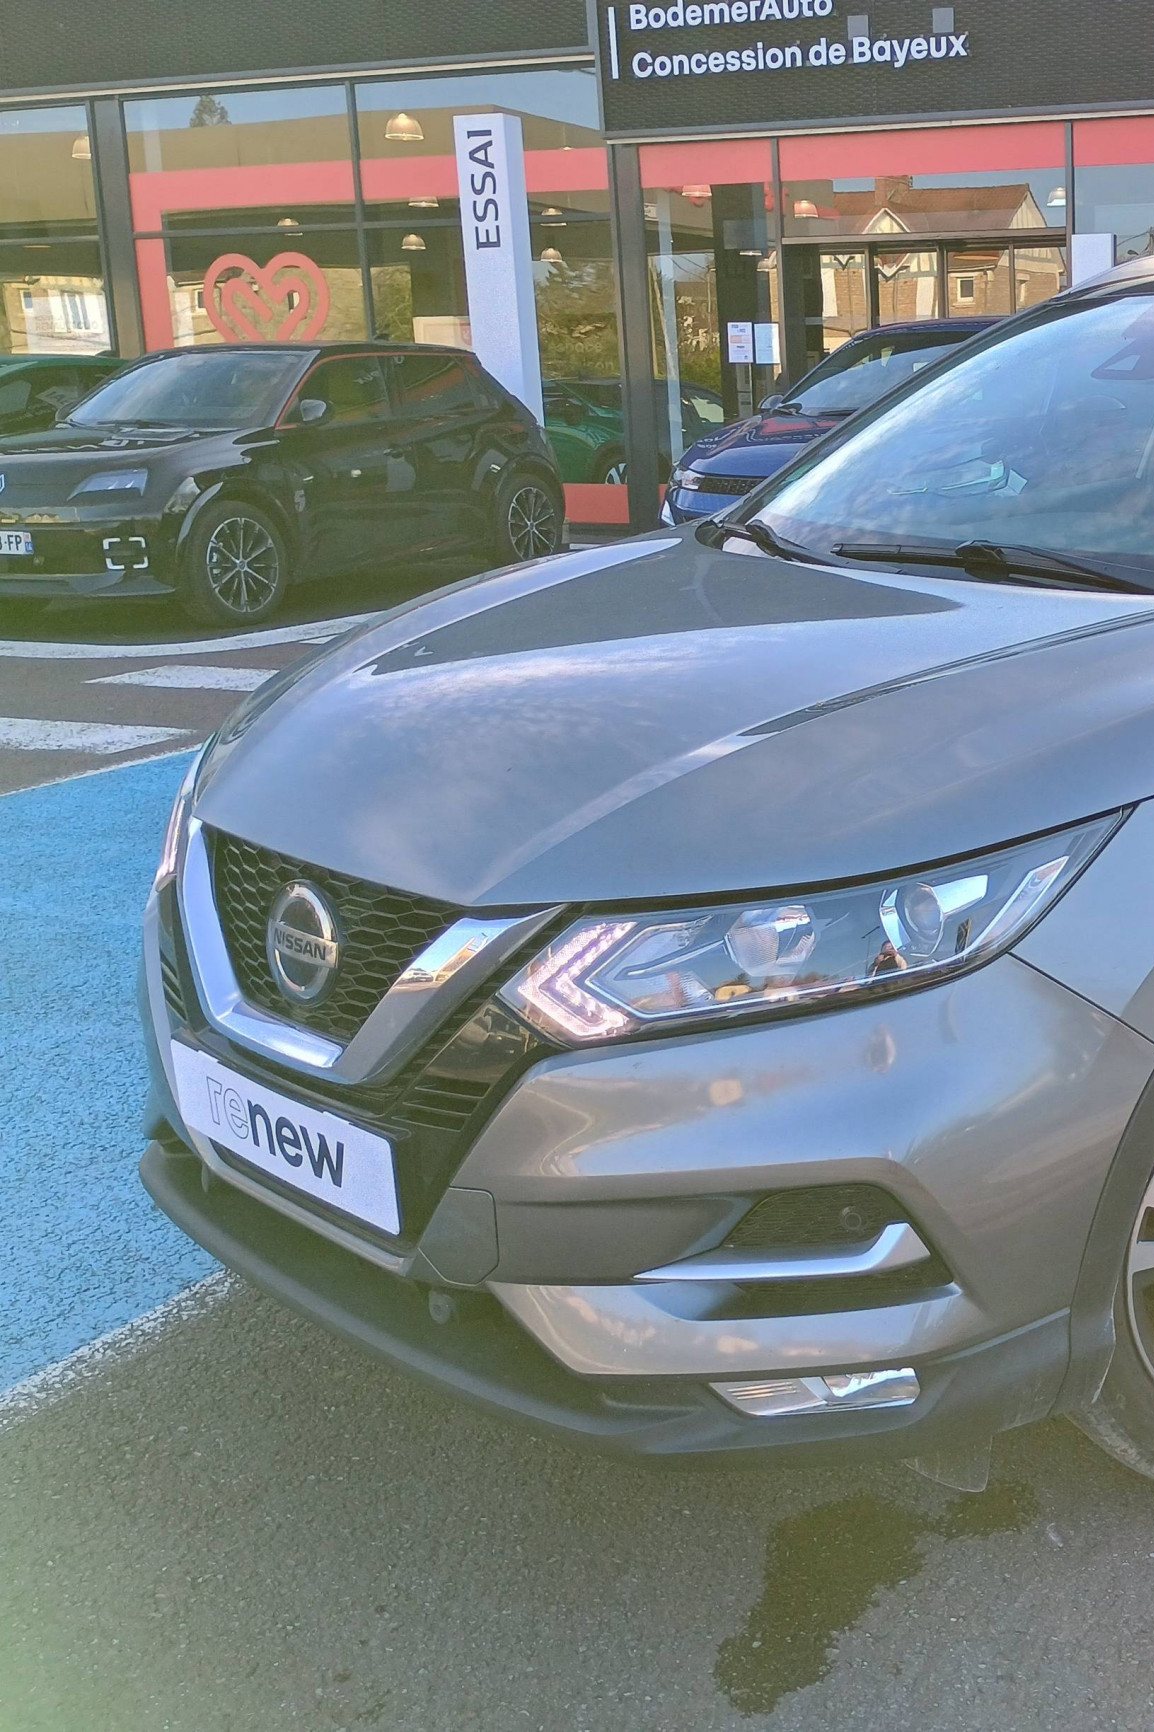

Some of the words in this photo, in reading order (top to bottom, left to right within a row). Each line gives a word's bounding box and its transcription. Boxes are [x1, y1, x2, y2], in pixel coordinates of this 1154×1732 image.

[629, 0, 833, 30] BodemerAuto
[632, 41, 803, 78] Concession
[808, 37, 846, 66] de
[852, 33, 968, 68] Bayeux
[466, 129, 501, 250] ESSAI
[273, 927, 327, 961] NISSAN
[206, 1075, 345, 1189] renew
